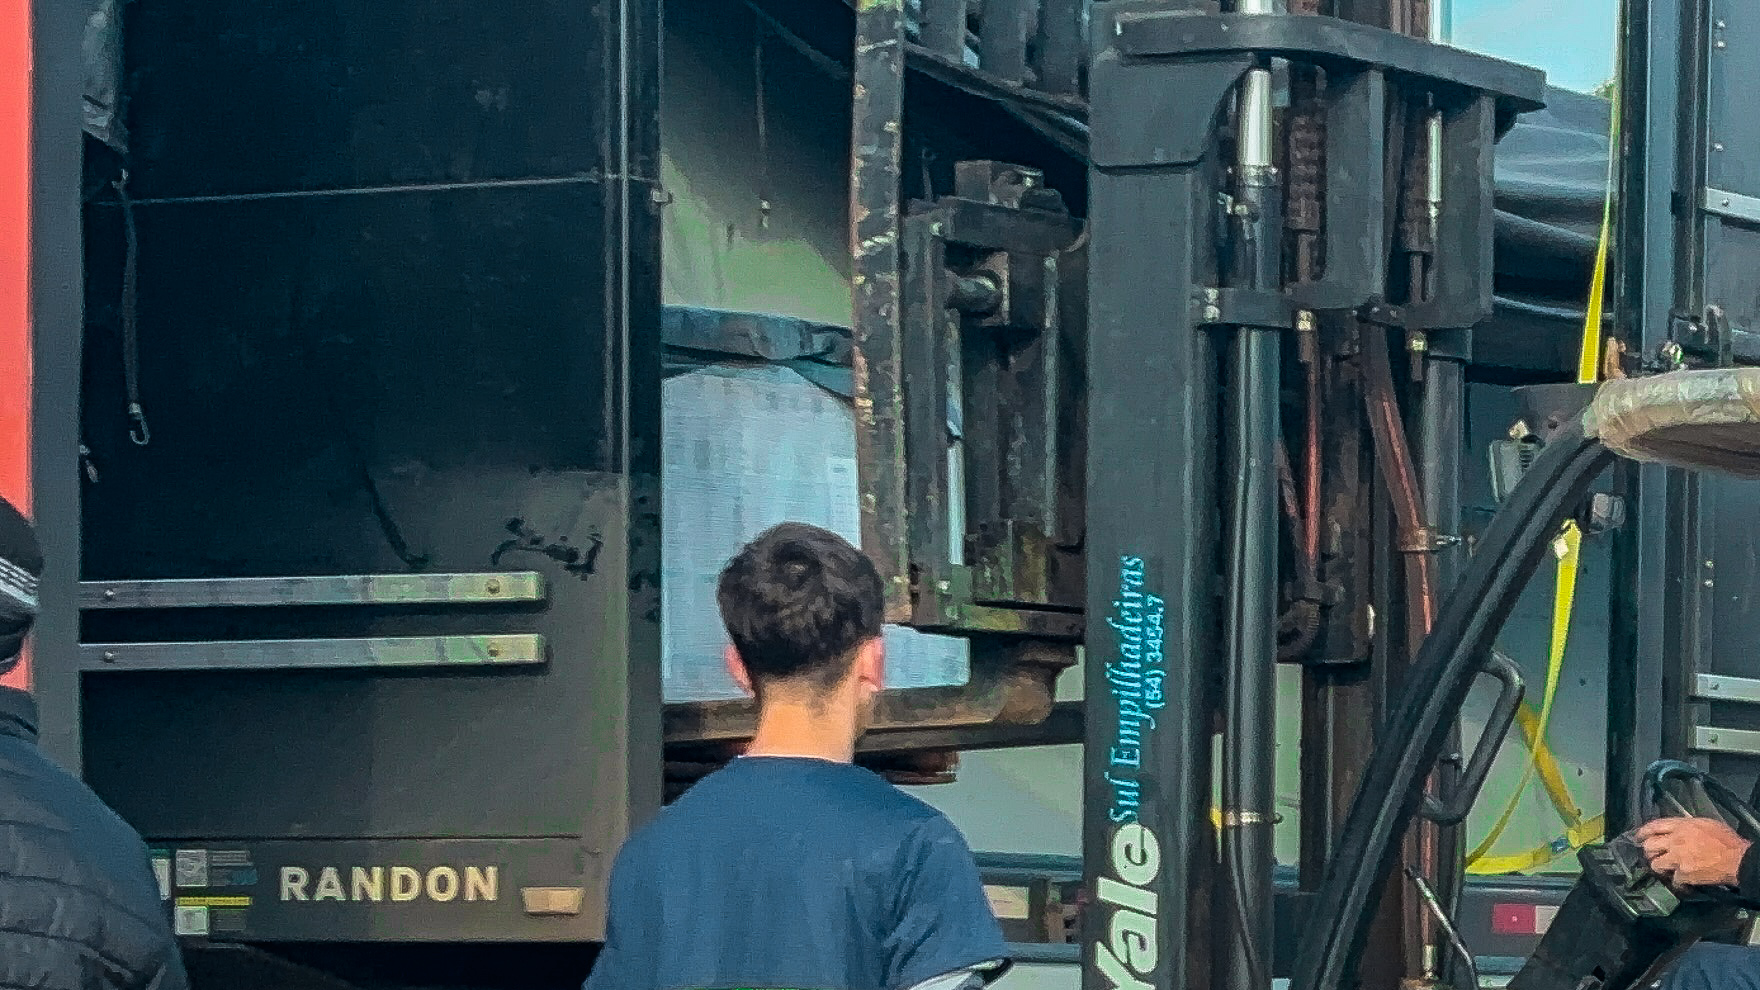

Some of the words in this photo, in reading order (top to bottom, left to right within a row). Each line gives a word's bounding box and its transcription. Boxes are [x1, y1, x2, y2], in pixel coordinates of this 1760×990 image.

[1105, 555, 1156, 768] Empilhadeiras
[1104, 771, 1138, 823] Sul
[280, 866, 498, 902] RANDON
